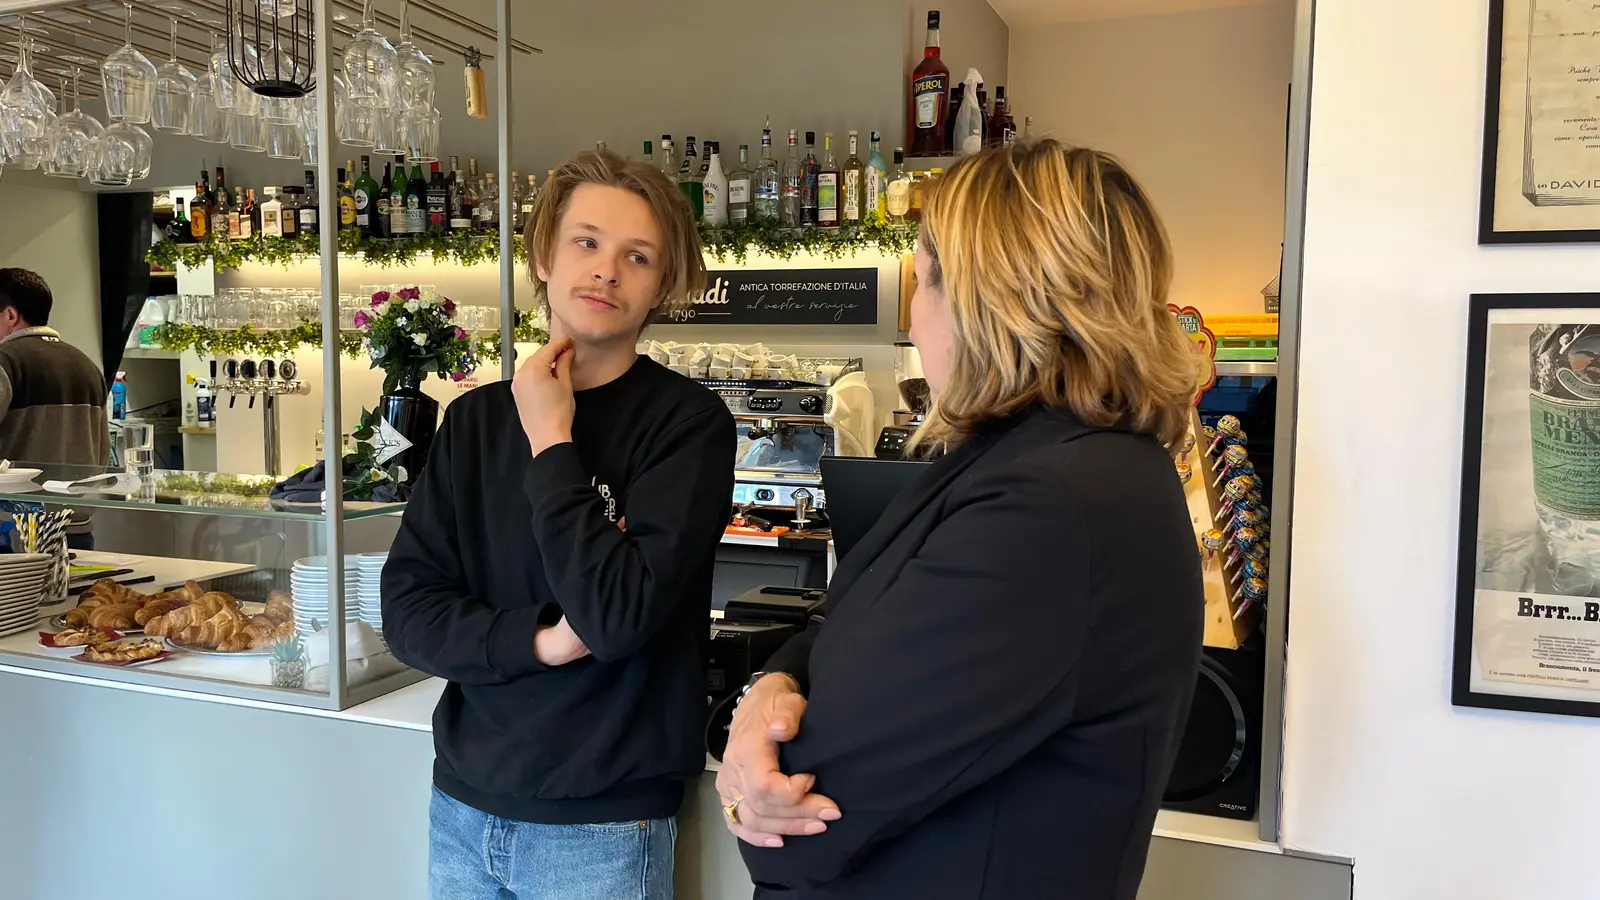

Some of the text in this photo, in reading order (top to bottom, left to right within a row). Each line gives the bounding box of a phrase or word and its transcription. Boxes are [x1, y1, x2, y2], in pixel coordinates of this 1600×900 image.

[914, 79, 943, 95] APEROL
[740, 282, 868, 292] ANTICA TORREFAZIONE D'ITALIA
[746, 294, 766, 310] al
[669, 309, 696, 323] 1790
[1219, 802, 1247, 811] CREATIVE
